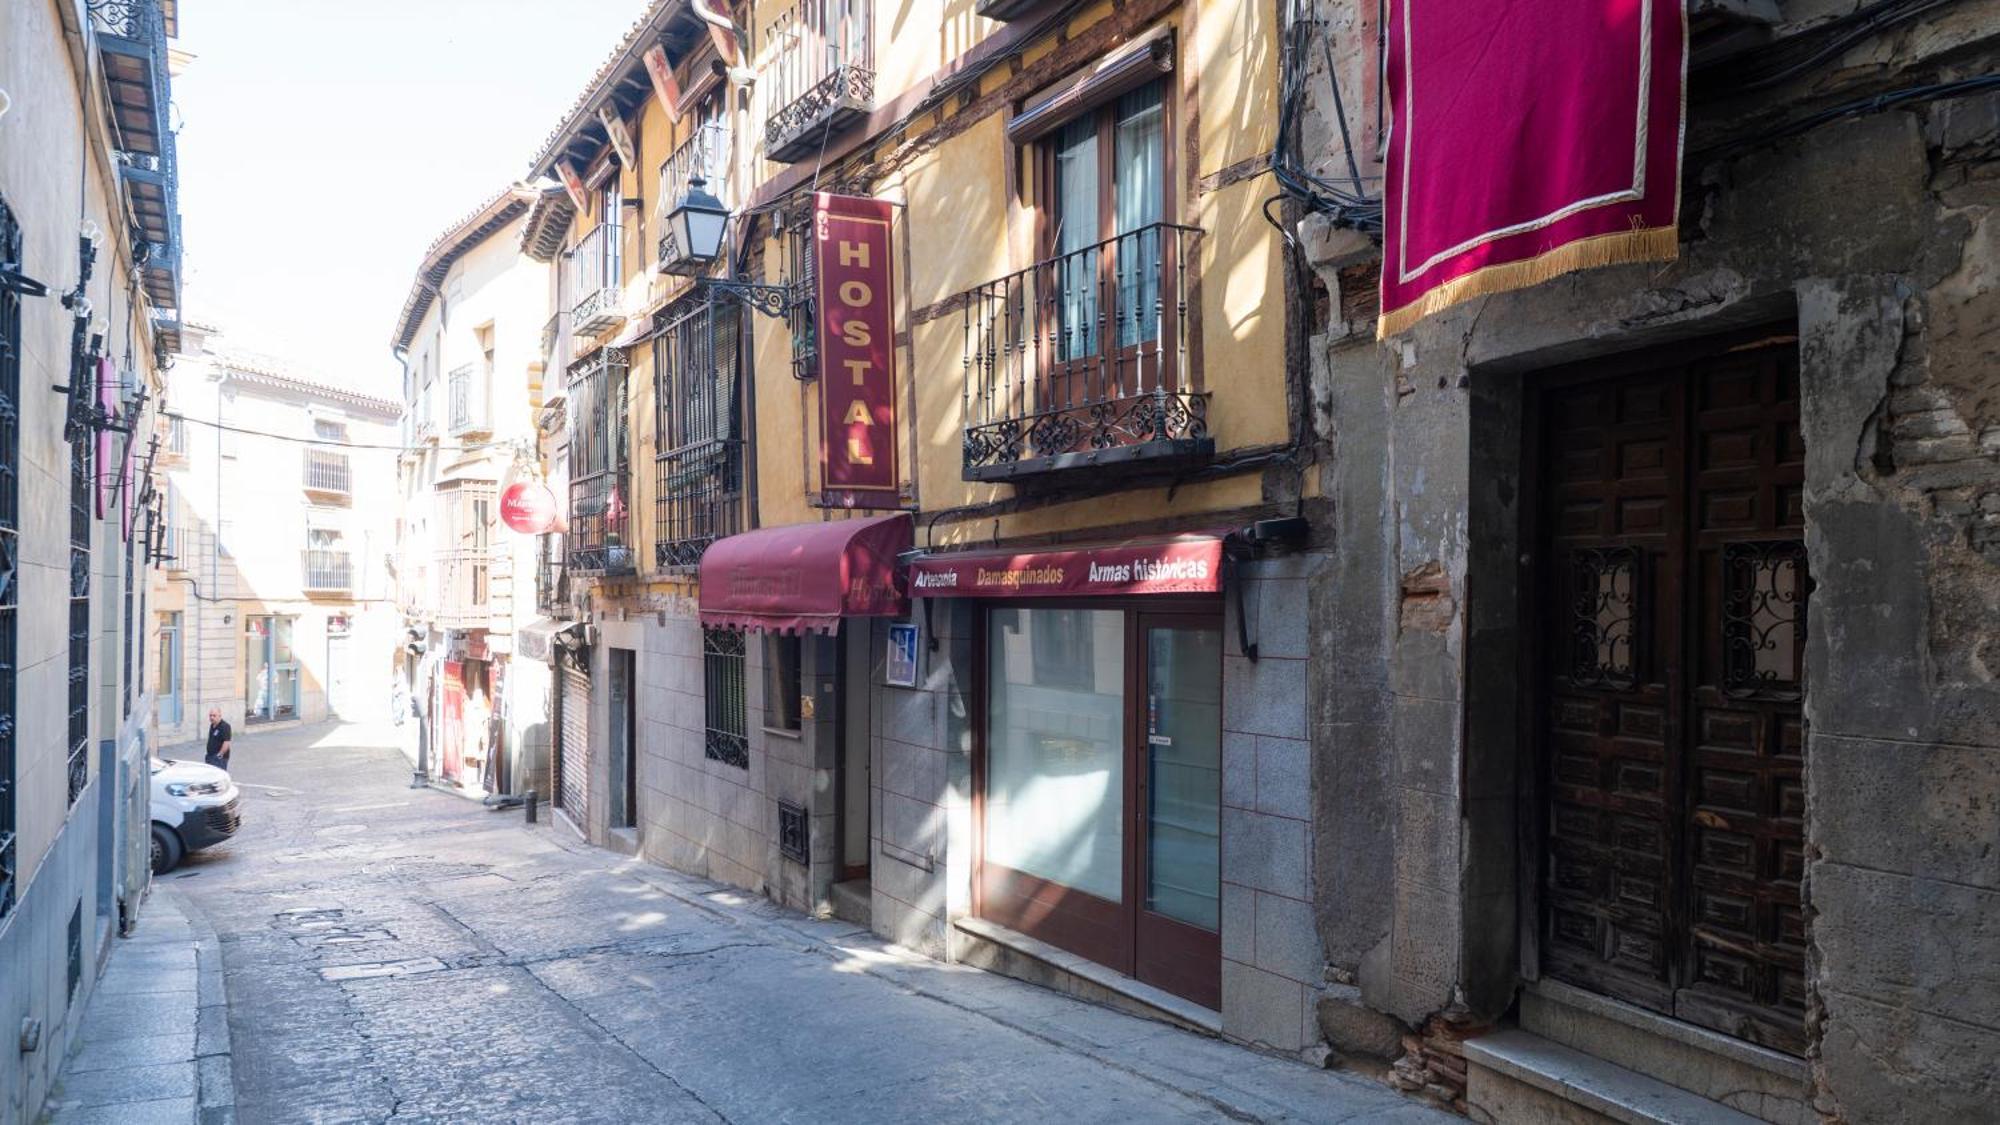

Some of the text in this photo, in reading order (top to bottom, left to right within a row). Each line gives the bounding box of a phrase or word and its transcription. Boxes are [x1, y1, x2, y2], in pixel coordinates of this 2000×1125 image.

[839, 240, 875, 465] HOSTAL
[977, 564, 1064, 590] Damasquinados
[1088, 561, 1131, 583] Armas
[1133, 556, 1209, 581] históricas
